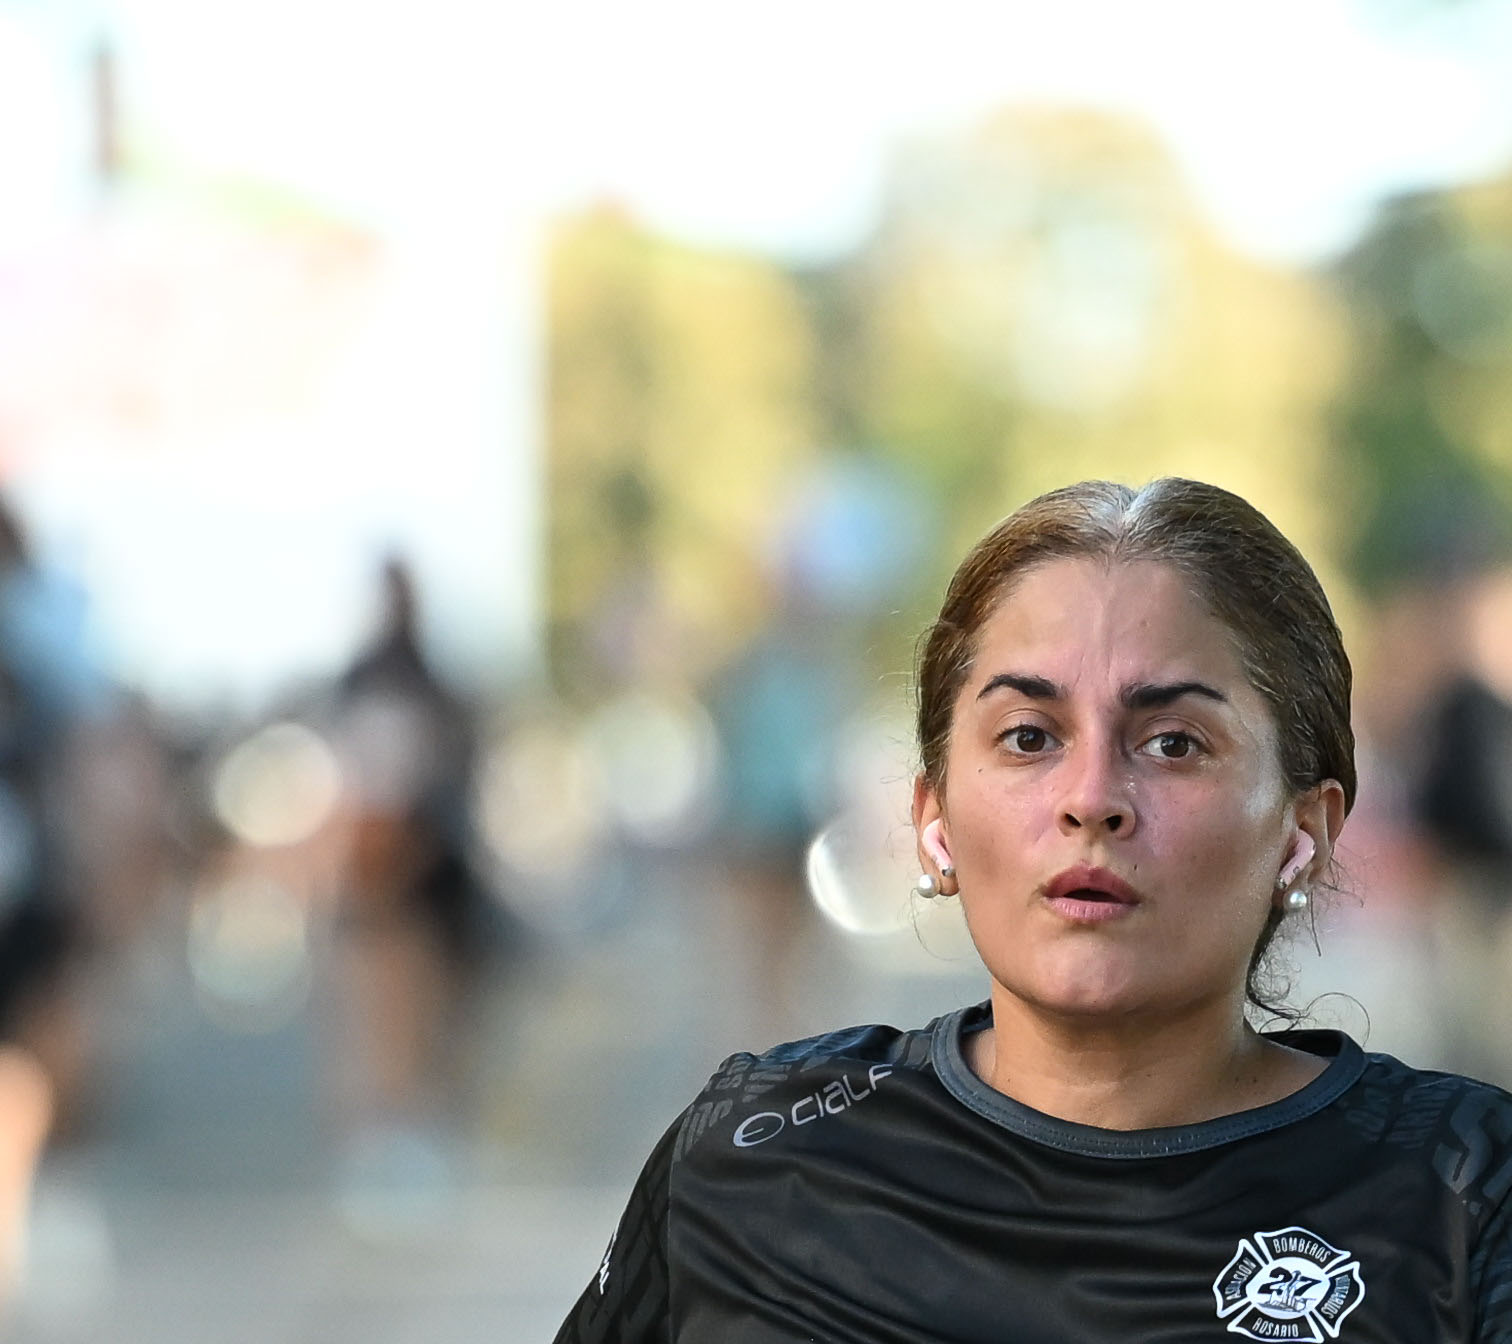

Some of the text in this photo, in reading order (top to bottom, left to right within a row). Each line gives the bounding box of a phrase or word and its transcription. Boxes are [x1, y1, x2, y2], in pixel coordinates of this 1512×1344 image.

[1273, 1237, 1331, 1263] BOMBEROS
[1257, 1266, 1322, 1297] 27
[1252, 1317, 1299, 1338] ROSARIO
